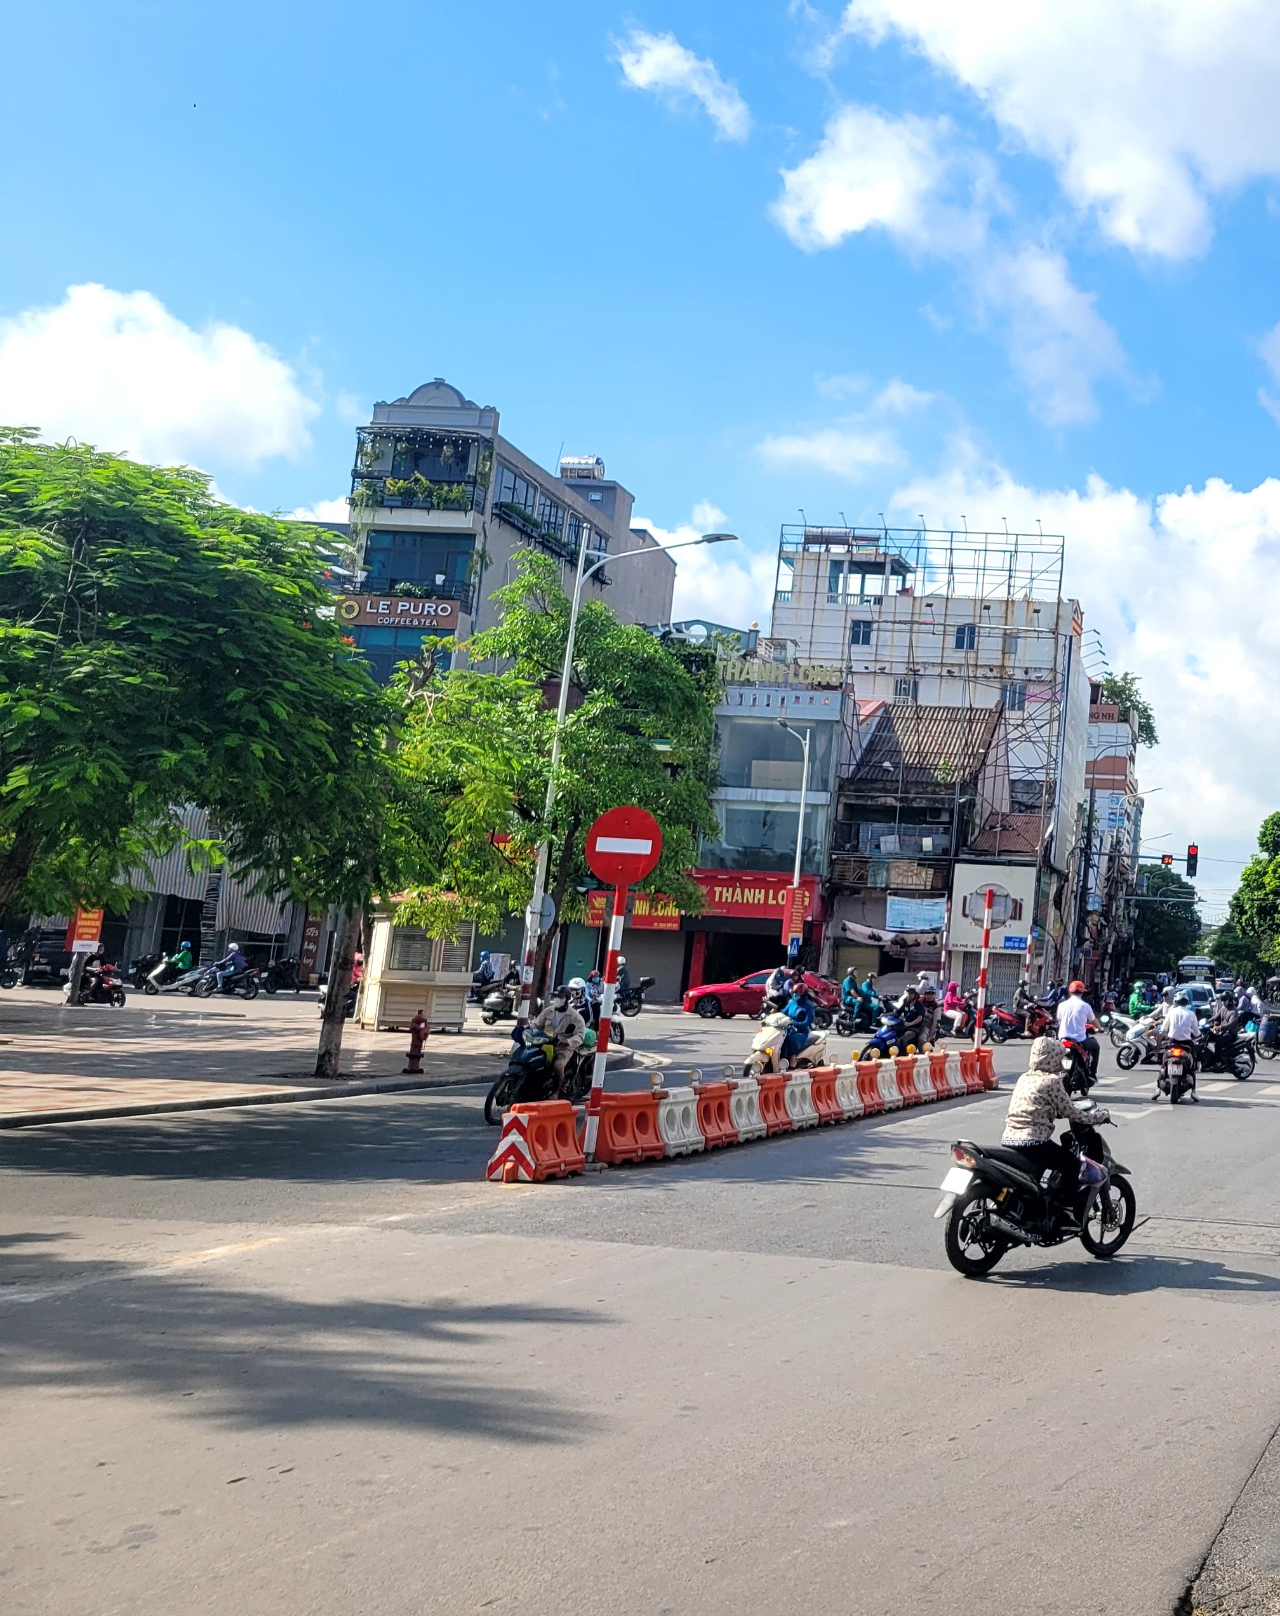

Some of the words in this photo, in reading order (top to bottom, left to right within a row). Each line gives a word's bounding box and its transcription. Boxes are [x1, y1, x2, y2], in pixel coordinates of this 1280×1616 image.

[366, 600, 391, 614] LE
[397, 601, 452, 616] PURO
[377, 617, 411, 625] COFFEE
[421, 619, 438, 627] TEA
[714, 882, 765, 904] THÀNH
